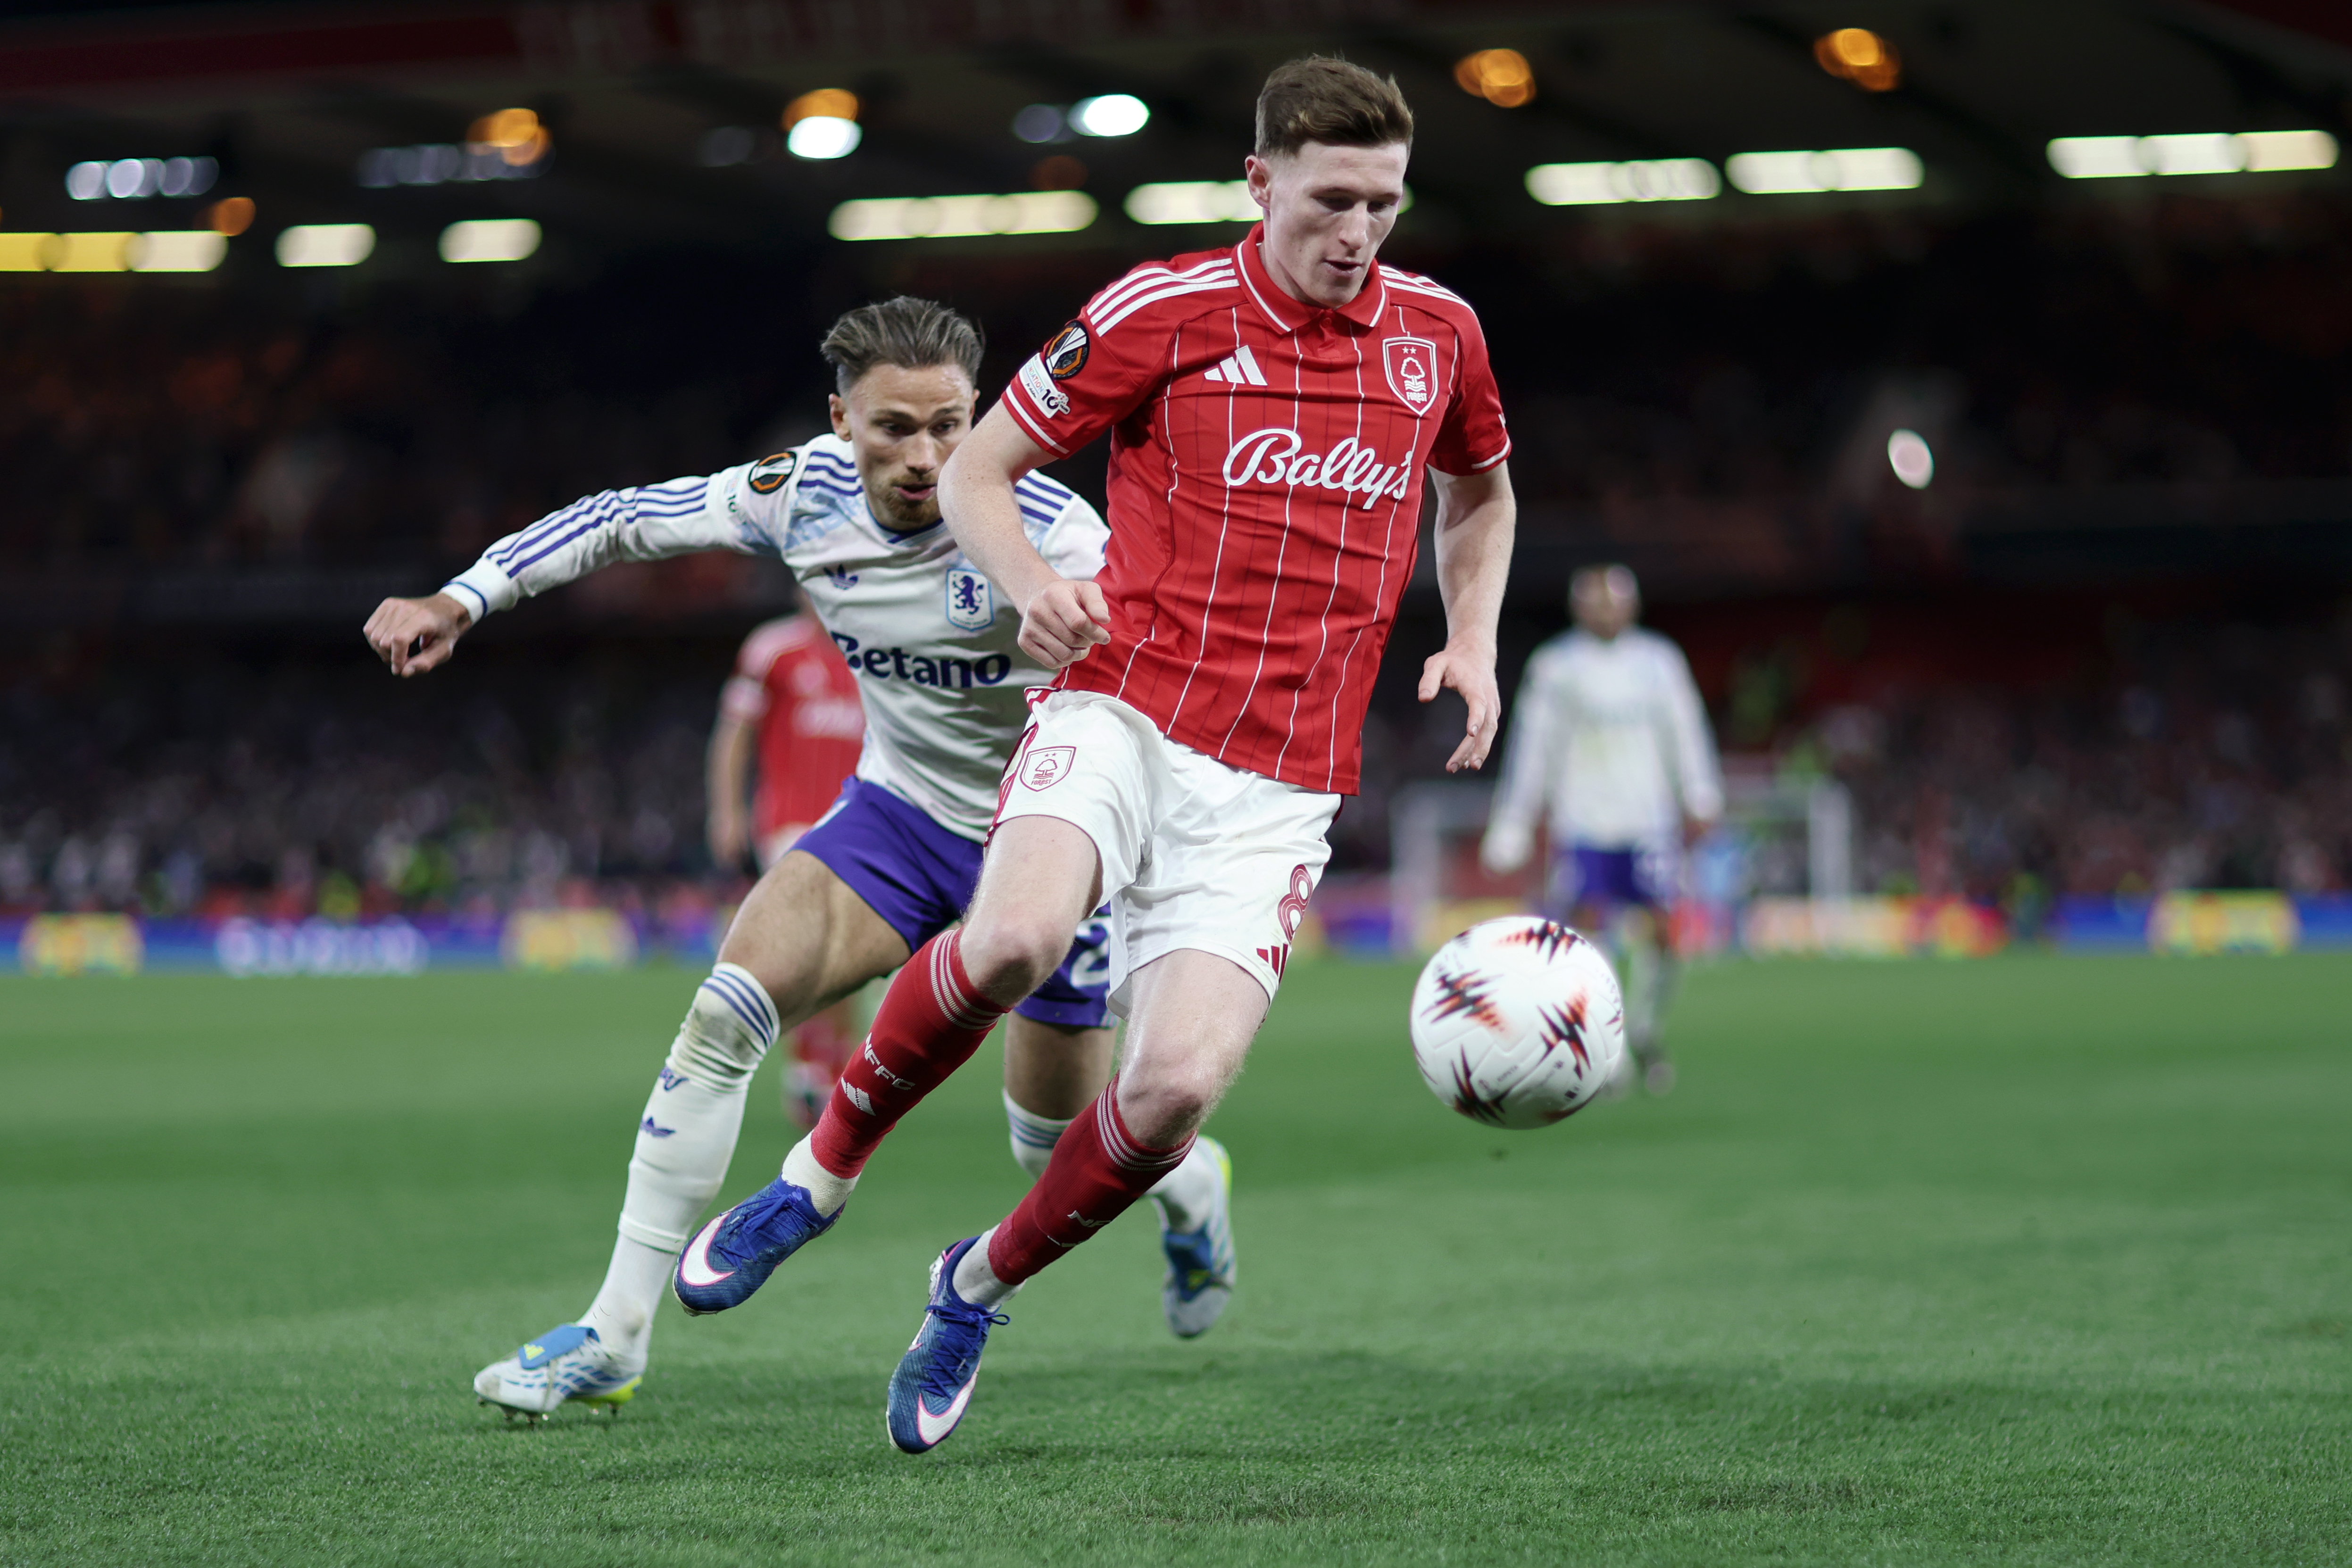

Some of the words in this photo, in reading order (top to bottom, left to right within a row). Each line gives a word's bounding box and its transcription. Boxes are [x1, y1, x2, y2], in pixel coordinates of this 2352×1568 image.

[1041, 389, 1059, 409] 10
[1406, 392, 1428, 404] FOREST
[1222, 428, 1413, 510] Bally's
[1277, 864, 1313, 943] 8
[1070, 916, 1112, 987] 2
[864, 1032, 916, 1091] NFFC
